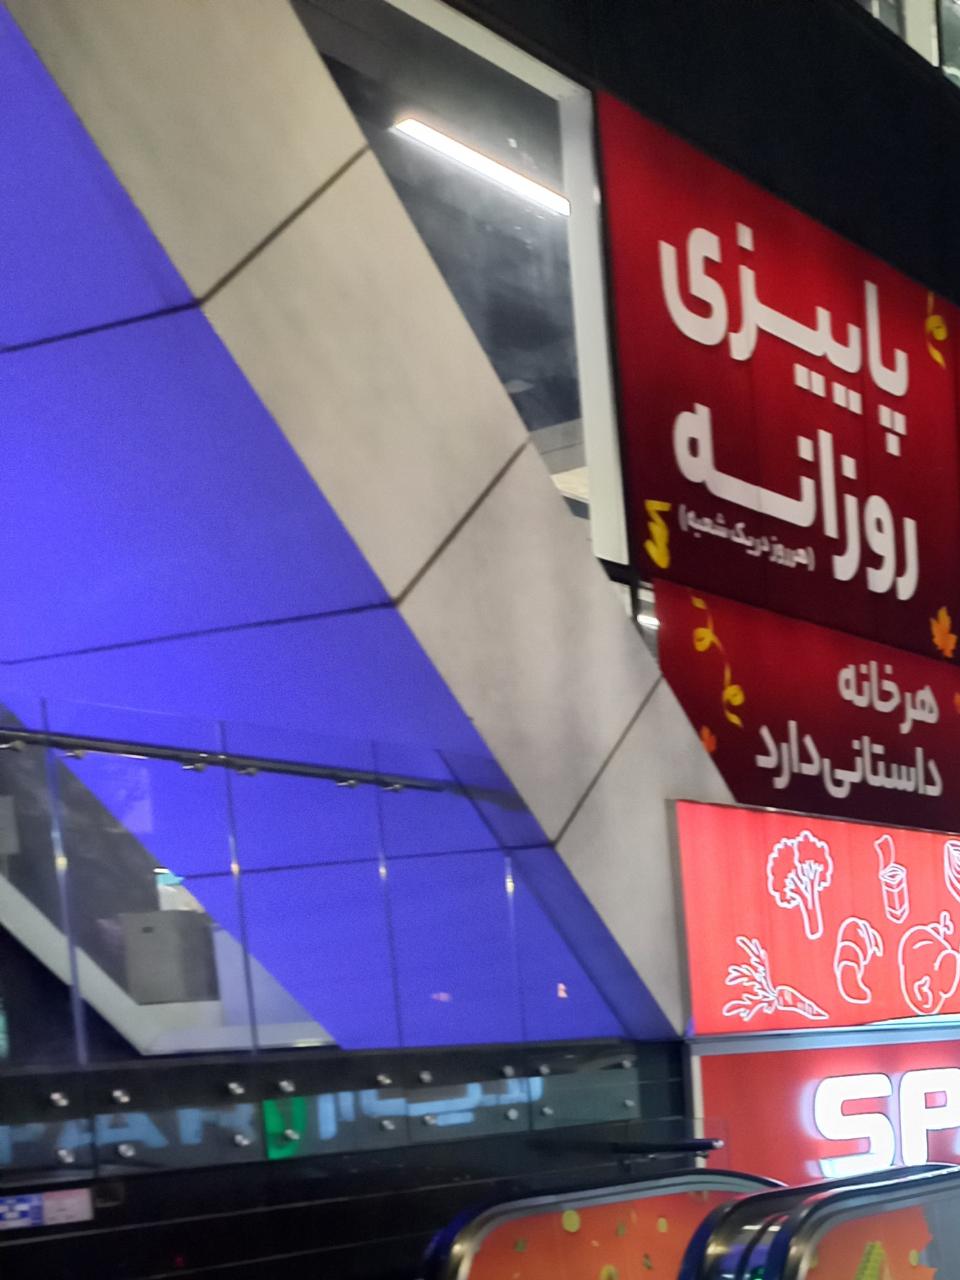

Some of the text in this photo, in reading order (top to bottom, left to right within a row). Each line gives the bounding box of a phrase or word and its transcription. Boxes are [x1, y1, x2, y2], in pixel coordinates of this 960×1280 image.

[658, 221, 910, 457] پاییزی
[672, 402, 919, 602] روزانه
[837, 660, 901, 713] خانه
[755, 719, 943, 799] داستانی دارد
